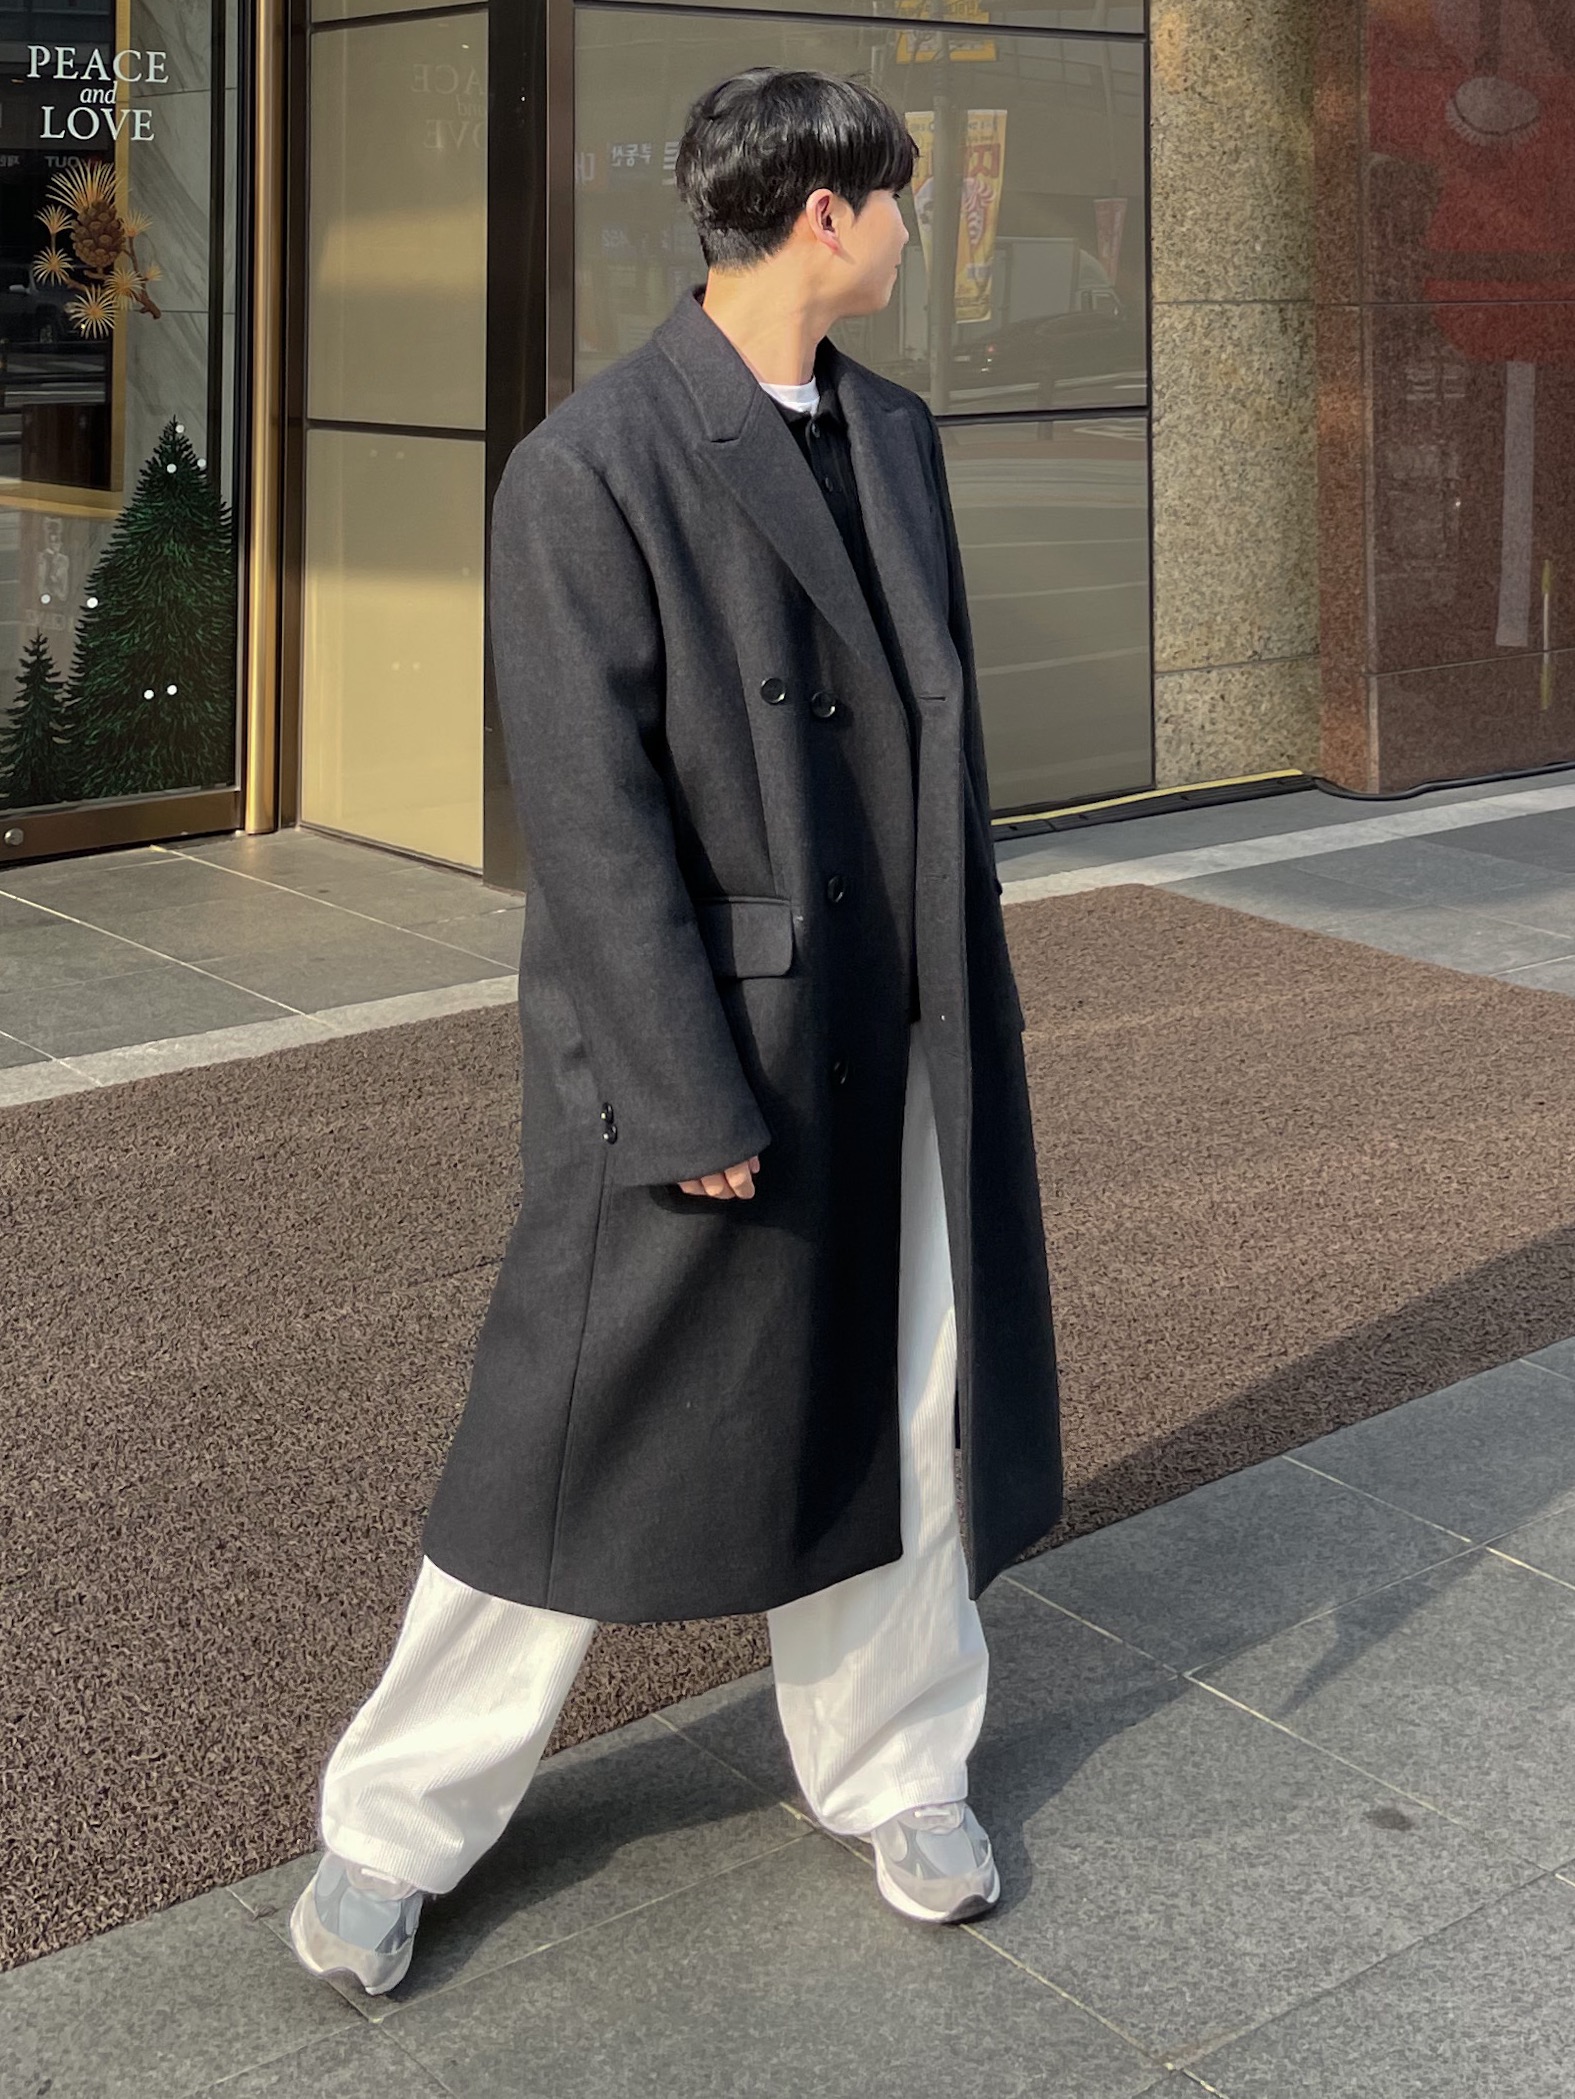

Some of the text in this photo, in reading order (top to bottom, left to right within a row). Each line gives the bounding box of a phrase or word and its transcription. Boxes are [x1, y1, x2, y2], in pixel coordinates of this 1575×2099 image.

[27, 45, 169, 83] PEACE
[80, 81, 117, 104] and
[40, 106, 155, 141] LOVE
